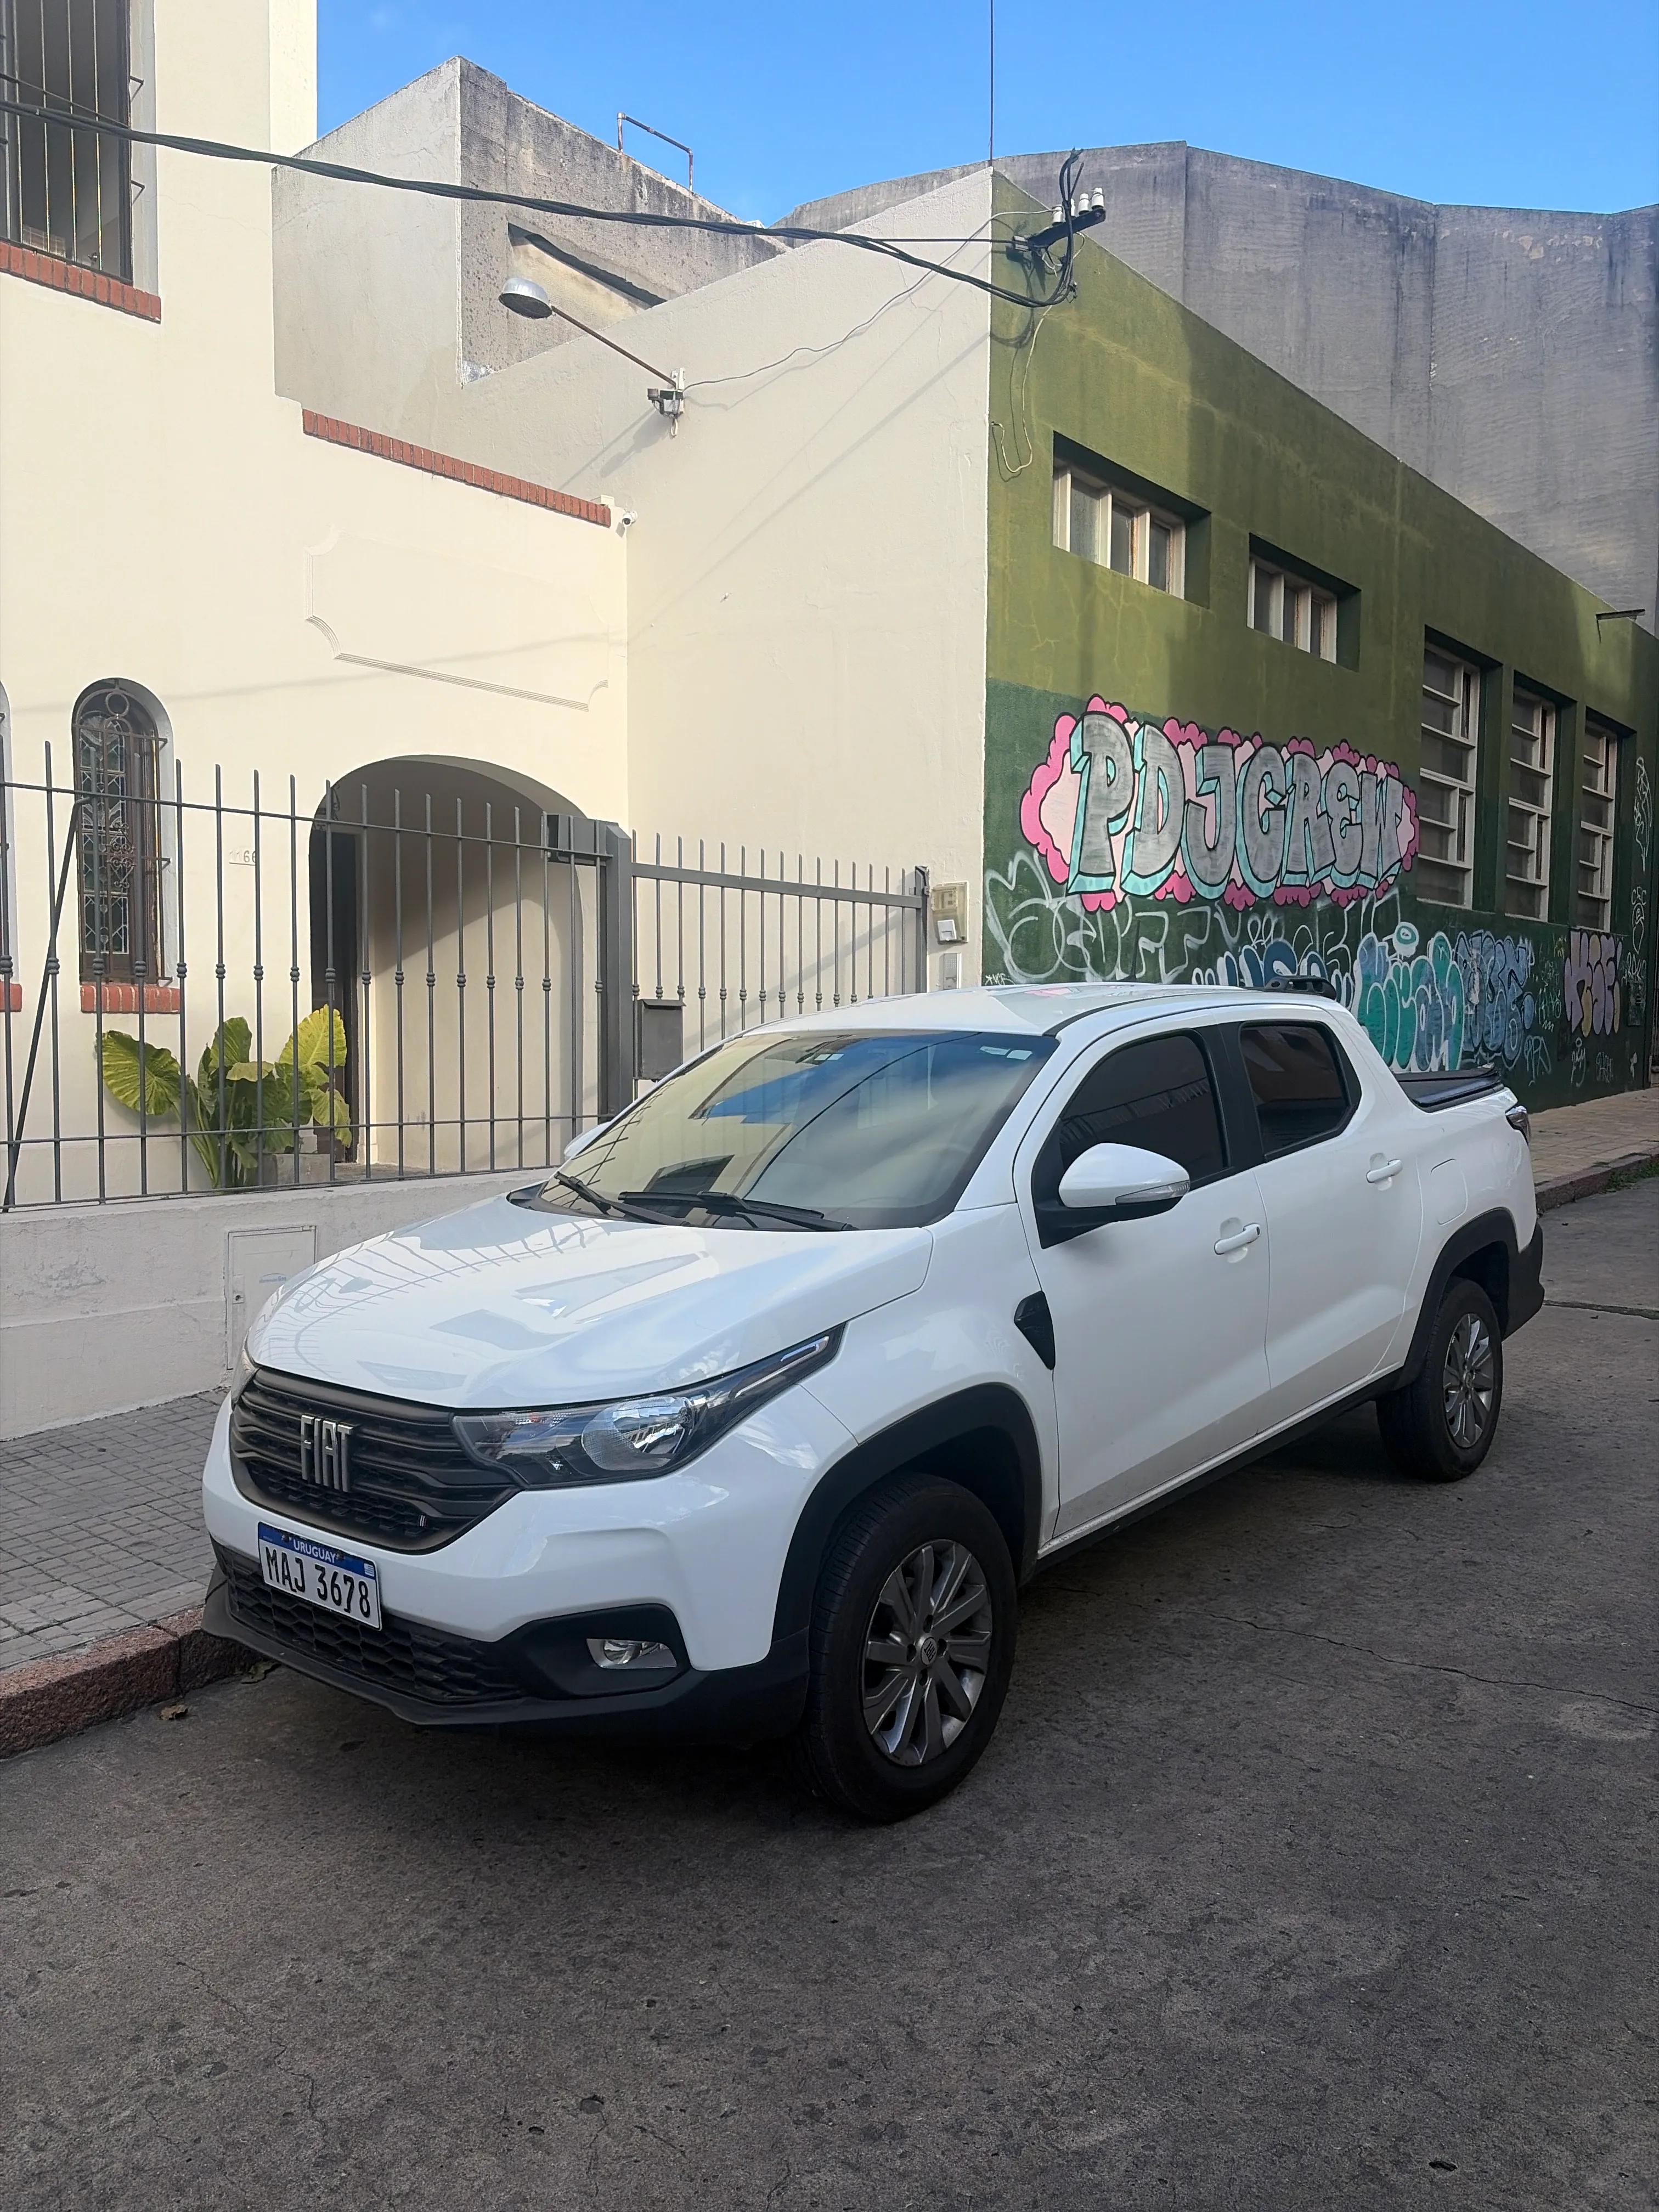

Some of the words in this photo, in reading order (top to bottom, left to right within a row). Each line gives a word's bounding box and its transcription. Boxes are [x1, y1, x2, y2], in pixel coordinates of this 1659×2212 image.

[301, 1415, 353, 1492] FIAT
[266, 1546, 305, 1593] MAJ
[314, 1564, 370, 1618] 3678
[293, 1539, 336, 1564] URUGUAY
